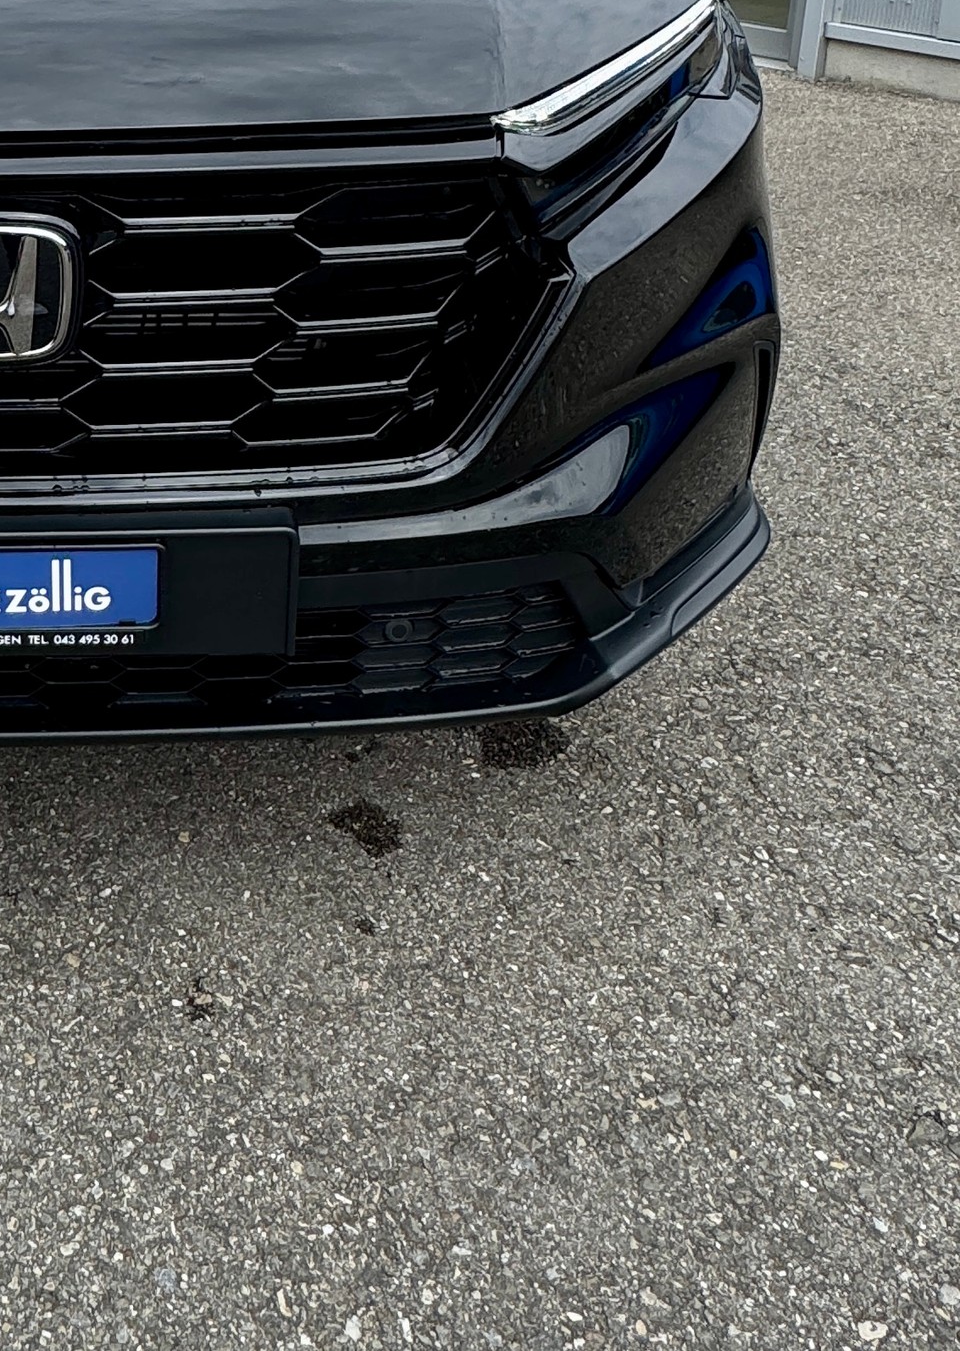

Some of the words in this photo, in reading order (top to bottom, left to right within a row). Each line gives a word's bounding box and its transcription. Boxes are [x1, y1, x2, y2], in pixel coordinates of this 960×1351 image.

[53, 634, 75, 645] 043
[79, 634, 100, 645] 495
[103, 634, 118, 645] 30
[121, 634, 134, 645] 61
